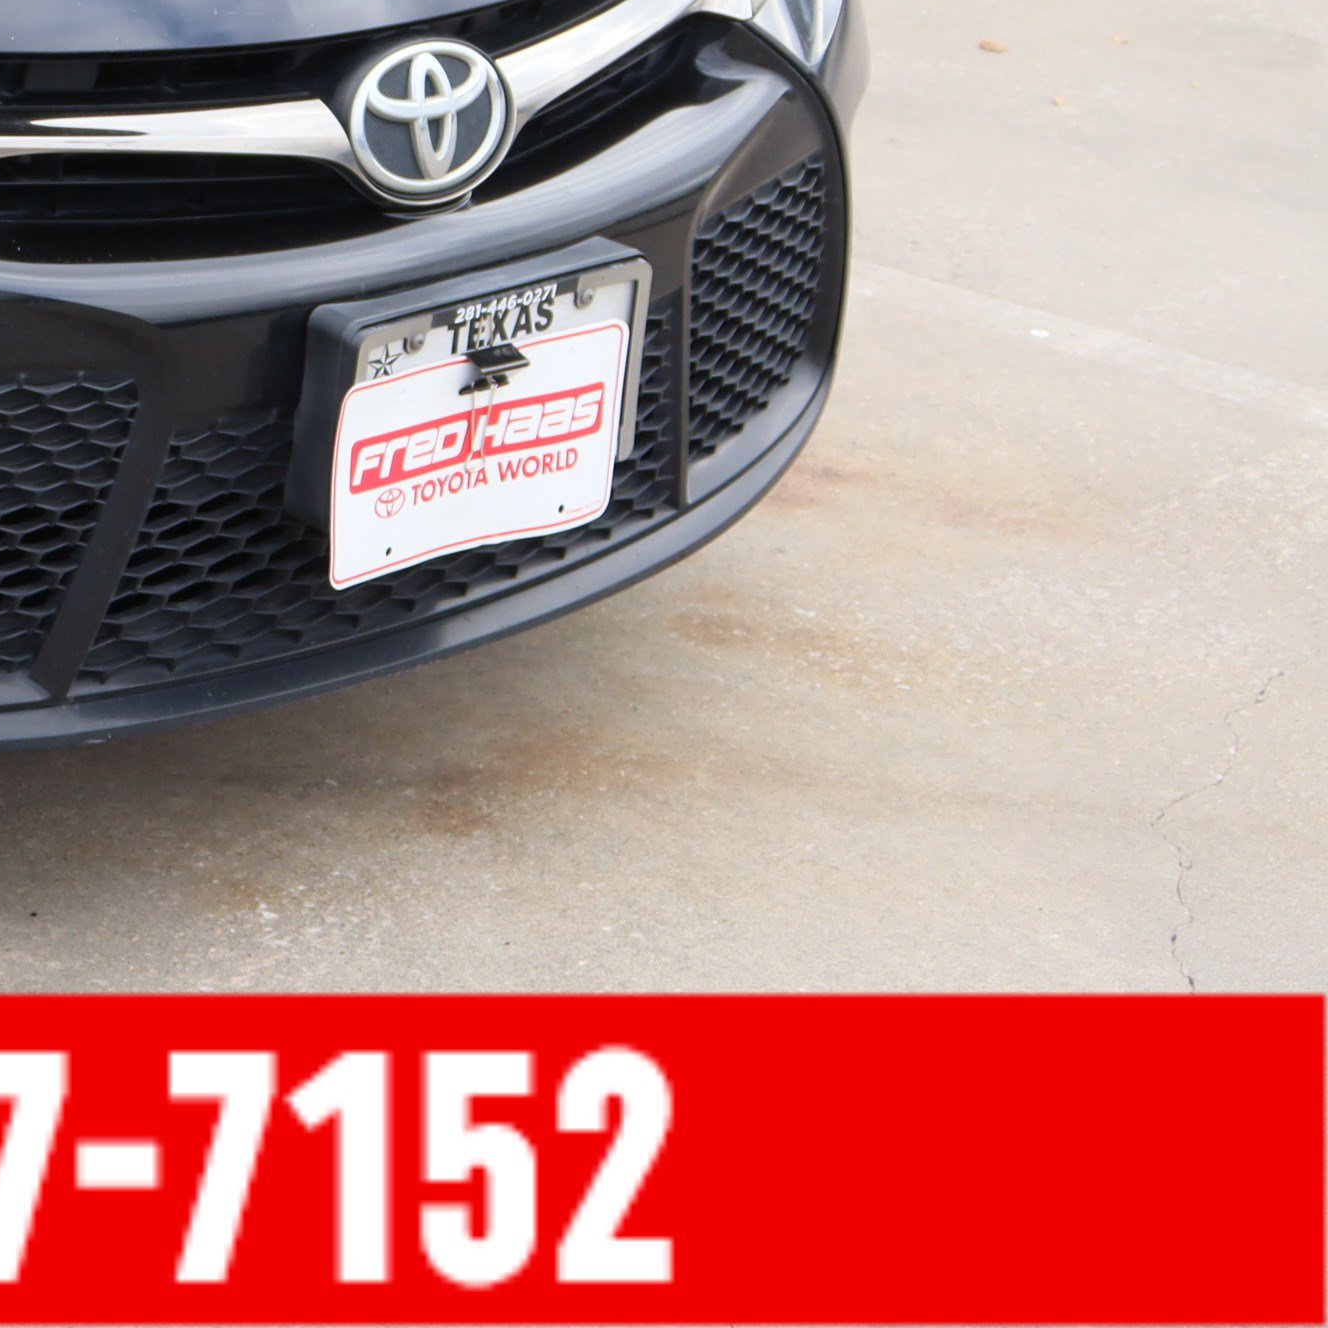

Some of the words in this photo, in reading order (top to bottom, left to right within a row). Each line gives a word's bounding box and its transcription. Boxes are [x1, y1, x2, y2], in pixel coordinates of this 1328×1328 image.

[446, 295, 556, 355] TEXAS
[453, 283, 559, 324] 281-446-0271
[411, 469, 488, 507] TOYOTA
[498, 447, 579, 483] WORLD
